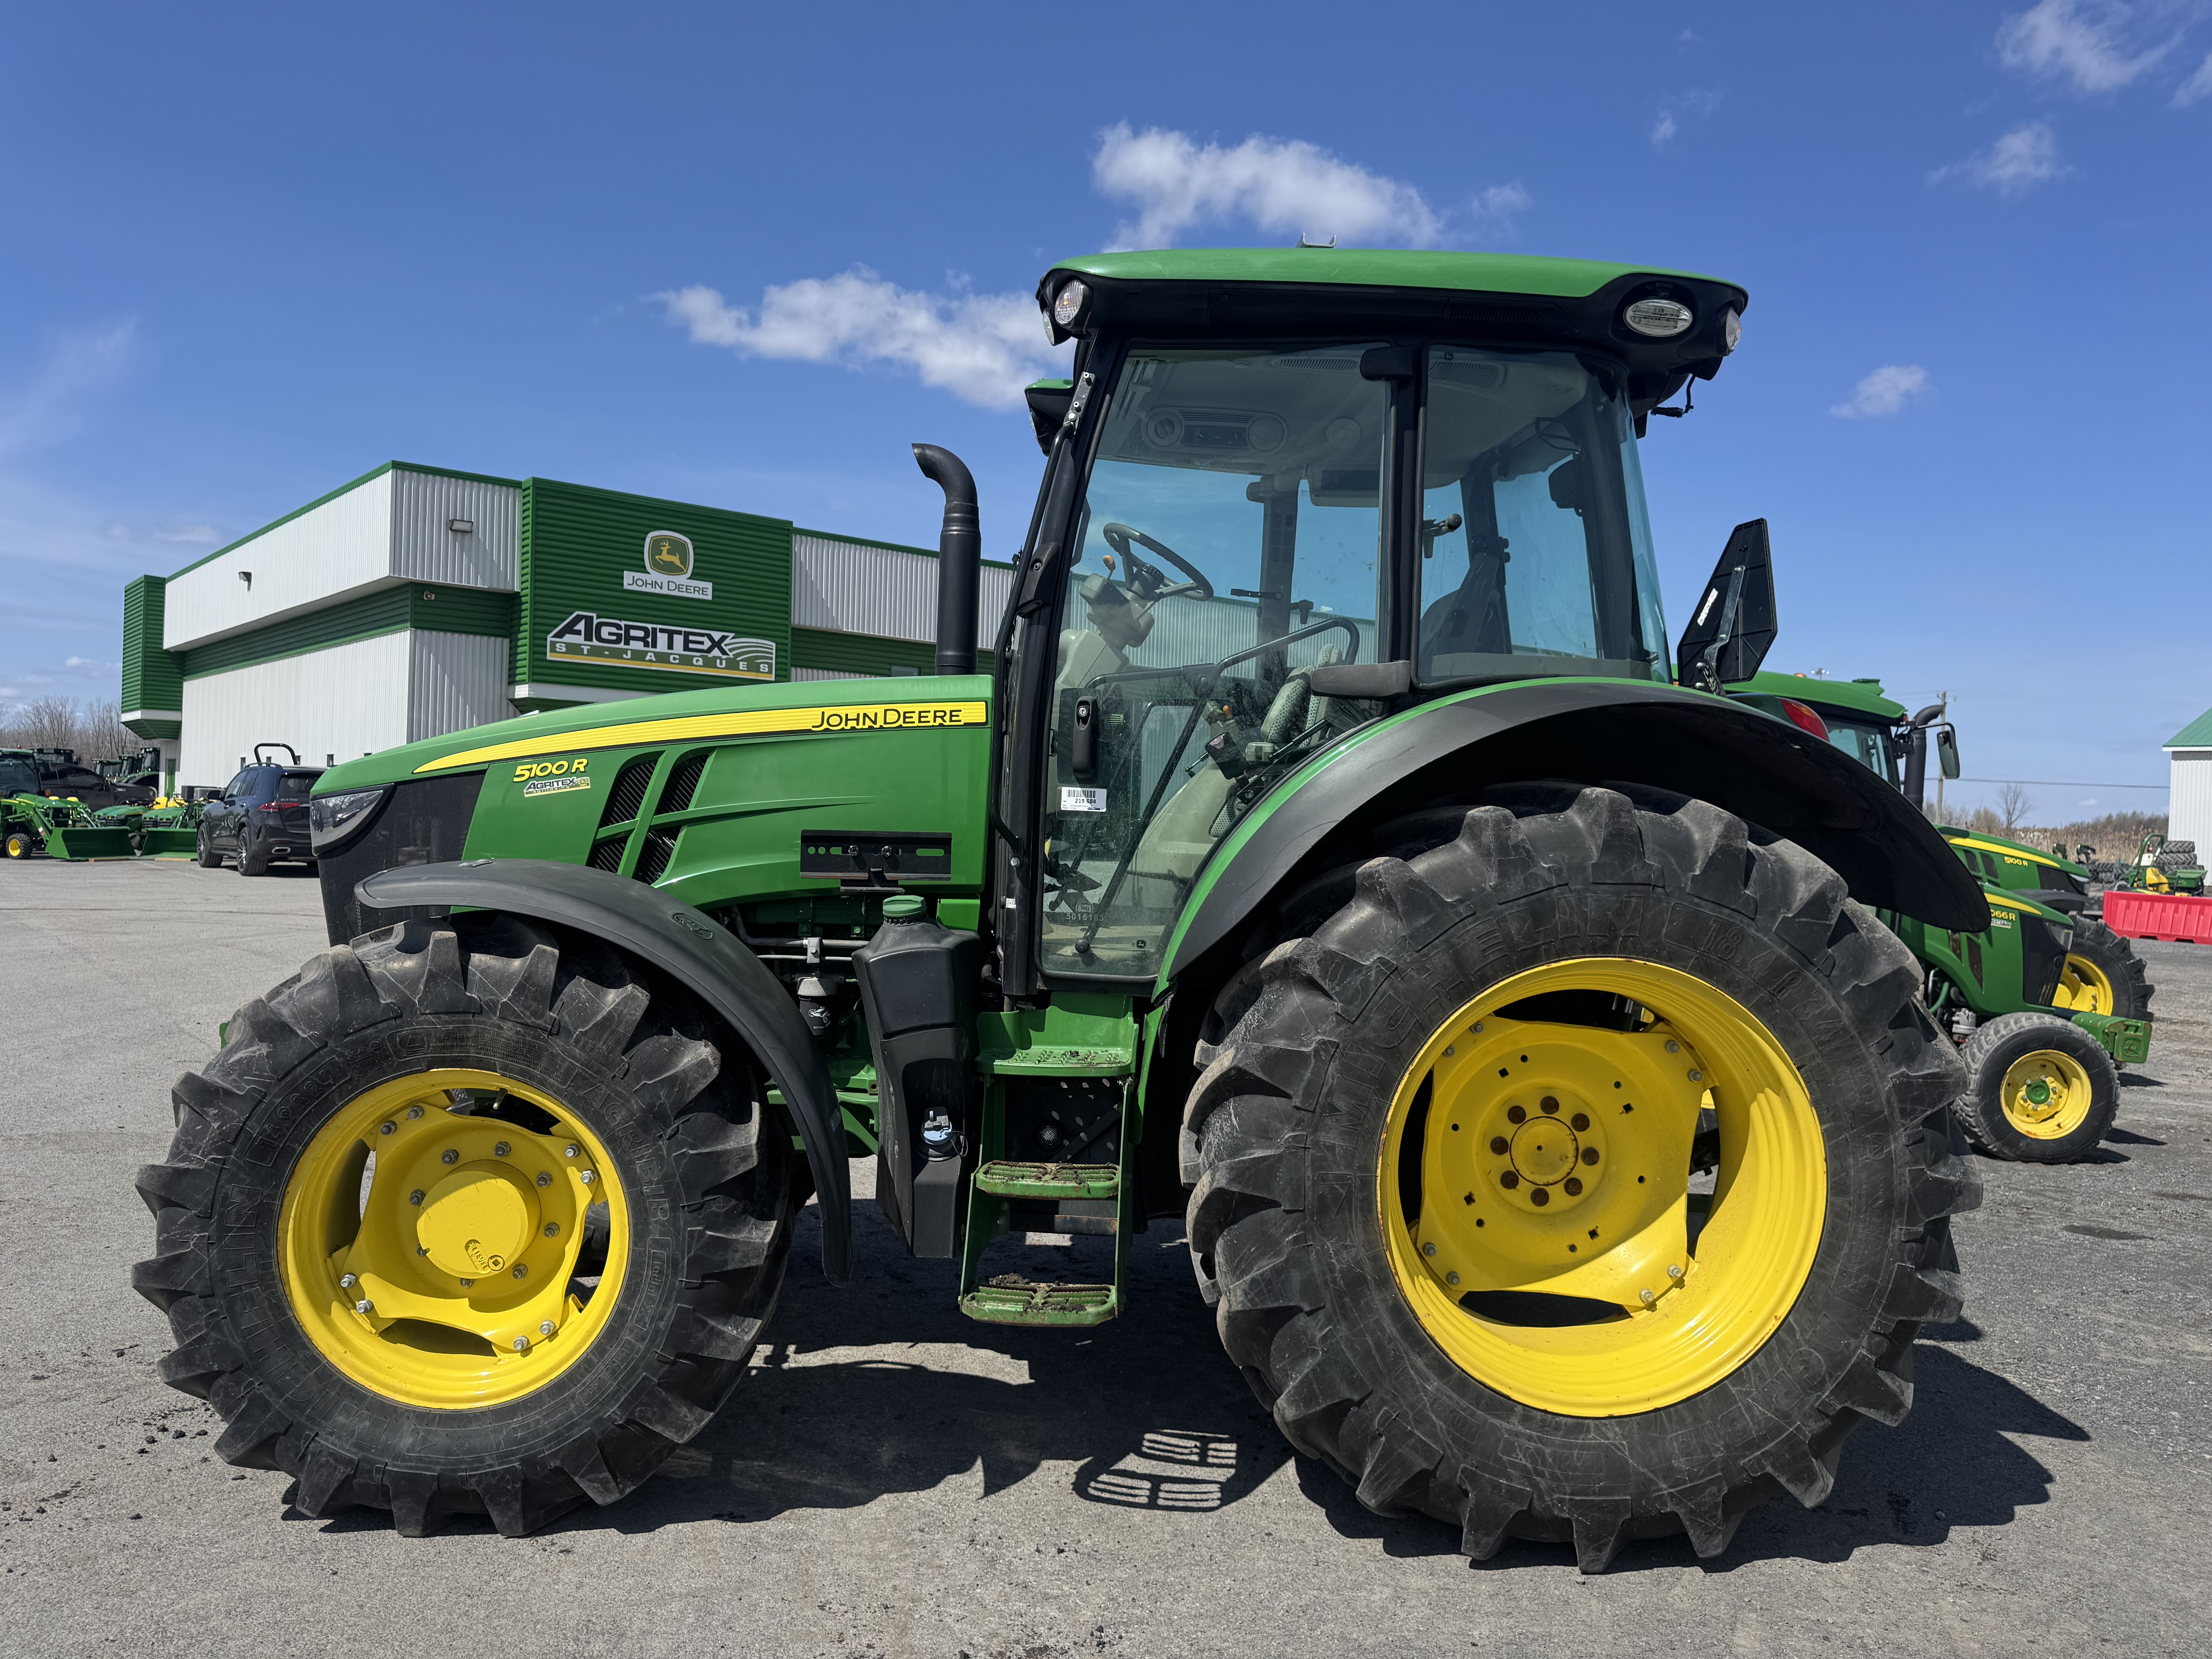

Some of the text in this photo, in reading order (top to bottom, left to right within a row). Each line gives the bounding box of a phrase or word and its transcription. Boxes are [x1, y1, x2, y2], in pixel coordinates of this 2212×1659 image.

[627, 575, 709, 596] JOHN DEERE
[550, 614, 730, 656] AGRITEX
[555, 643, 769, 673] ST-JACQUES
[812, 709, 962, 728] JOHN DEERE
[513, 758, 588, 781] 5100 R
[525, 778, 576, 791] AGRITEX
[2004, 856, 2022, 865] 5100
[1066, 913, 1104, 921] 5016163
[1990, 909, 2016, 921] 066 R
[584, 1080, 669, 1221] AGRIBIB
[223, 1183, 388, 1449] MICHELIN
